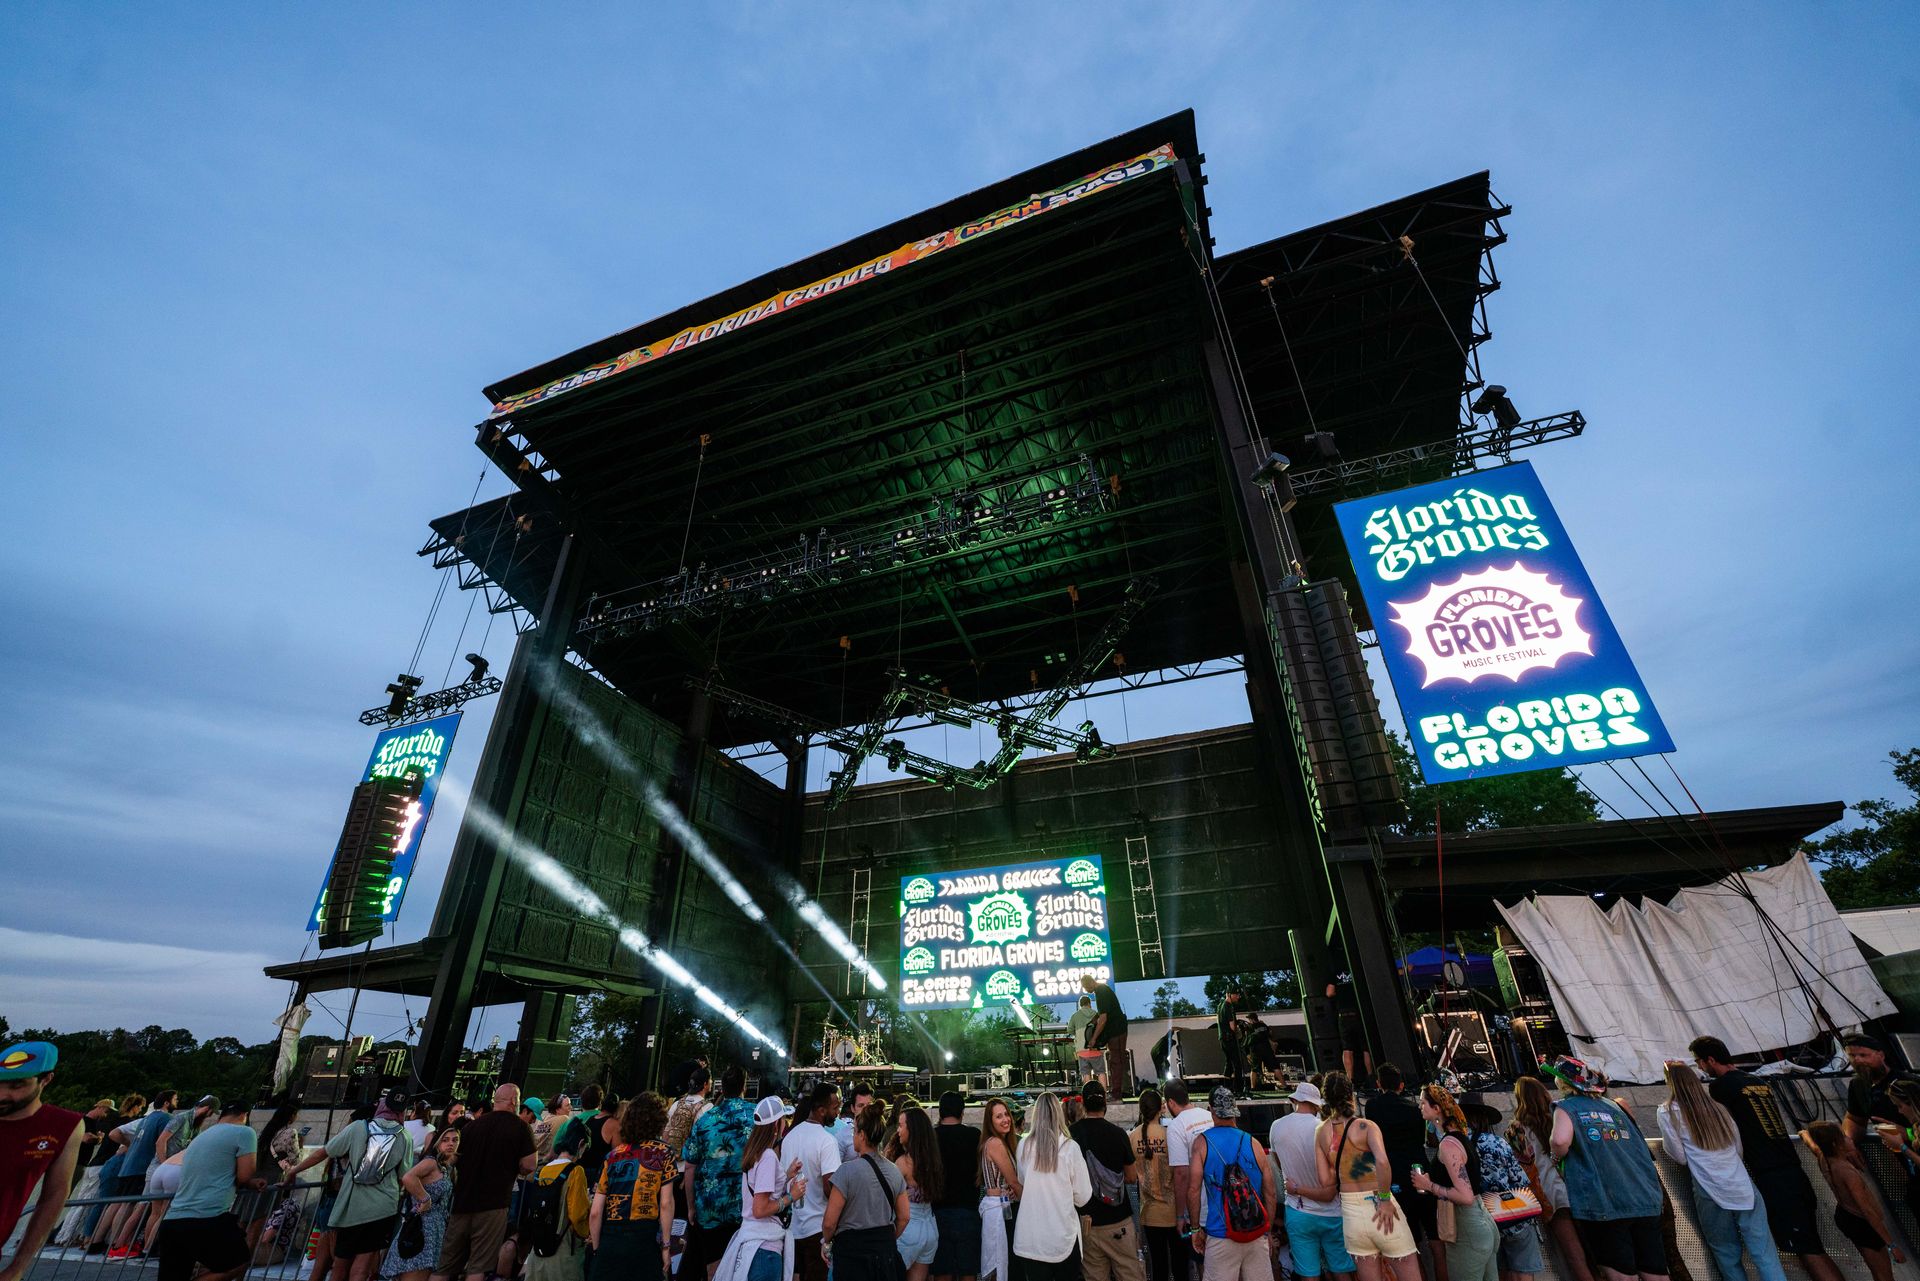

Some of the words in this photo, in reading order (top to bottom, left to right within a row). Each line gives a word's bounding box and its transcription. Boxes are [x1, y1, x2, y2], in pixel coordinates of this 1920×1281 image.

[966, 201, 1042, 237] MAIN
[1049, 161, 1146, 209] STAGE
[666, 299, 778, 354] FLORIDA
[1364, 488, 1537, 548] Florida
[1369, 521, 1550, 582] Groves
[1439, 589, 1524, 621] FLORIDA
[1426, 603, 1563, 658] GROVES
[1462, 656, 1494, 669] MUSIC
[1496, 647, 1548, 663] FESTIVAL
[1420, 687, 1642, 744] FLORIDA
[377, 727, 445, 765] Florida
[1434, 716, 1650, 770] GROVES
[904, 904, 965, 928] Florida
[1035, 890, 1103, 916] Florida
[904, 923, 965, 947] Groves
[977, 911, 1022, 931] GROVES
[1035, 911, 1105, 936] Groves
[941, 945, 1005, 970] FLORIDA
[1007, 940, 1065, 966] GROVES
[903, 975, 972, 993] FLORIDA
[903, 988, 971, 1005] GROVES
[1137, 1139, 1165, 1147] MLKY
